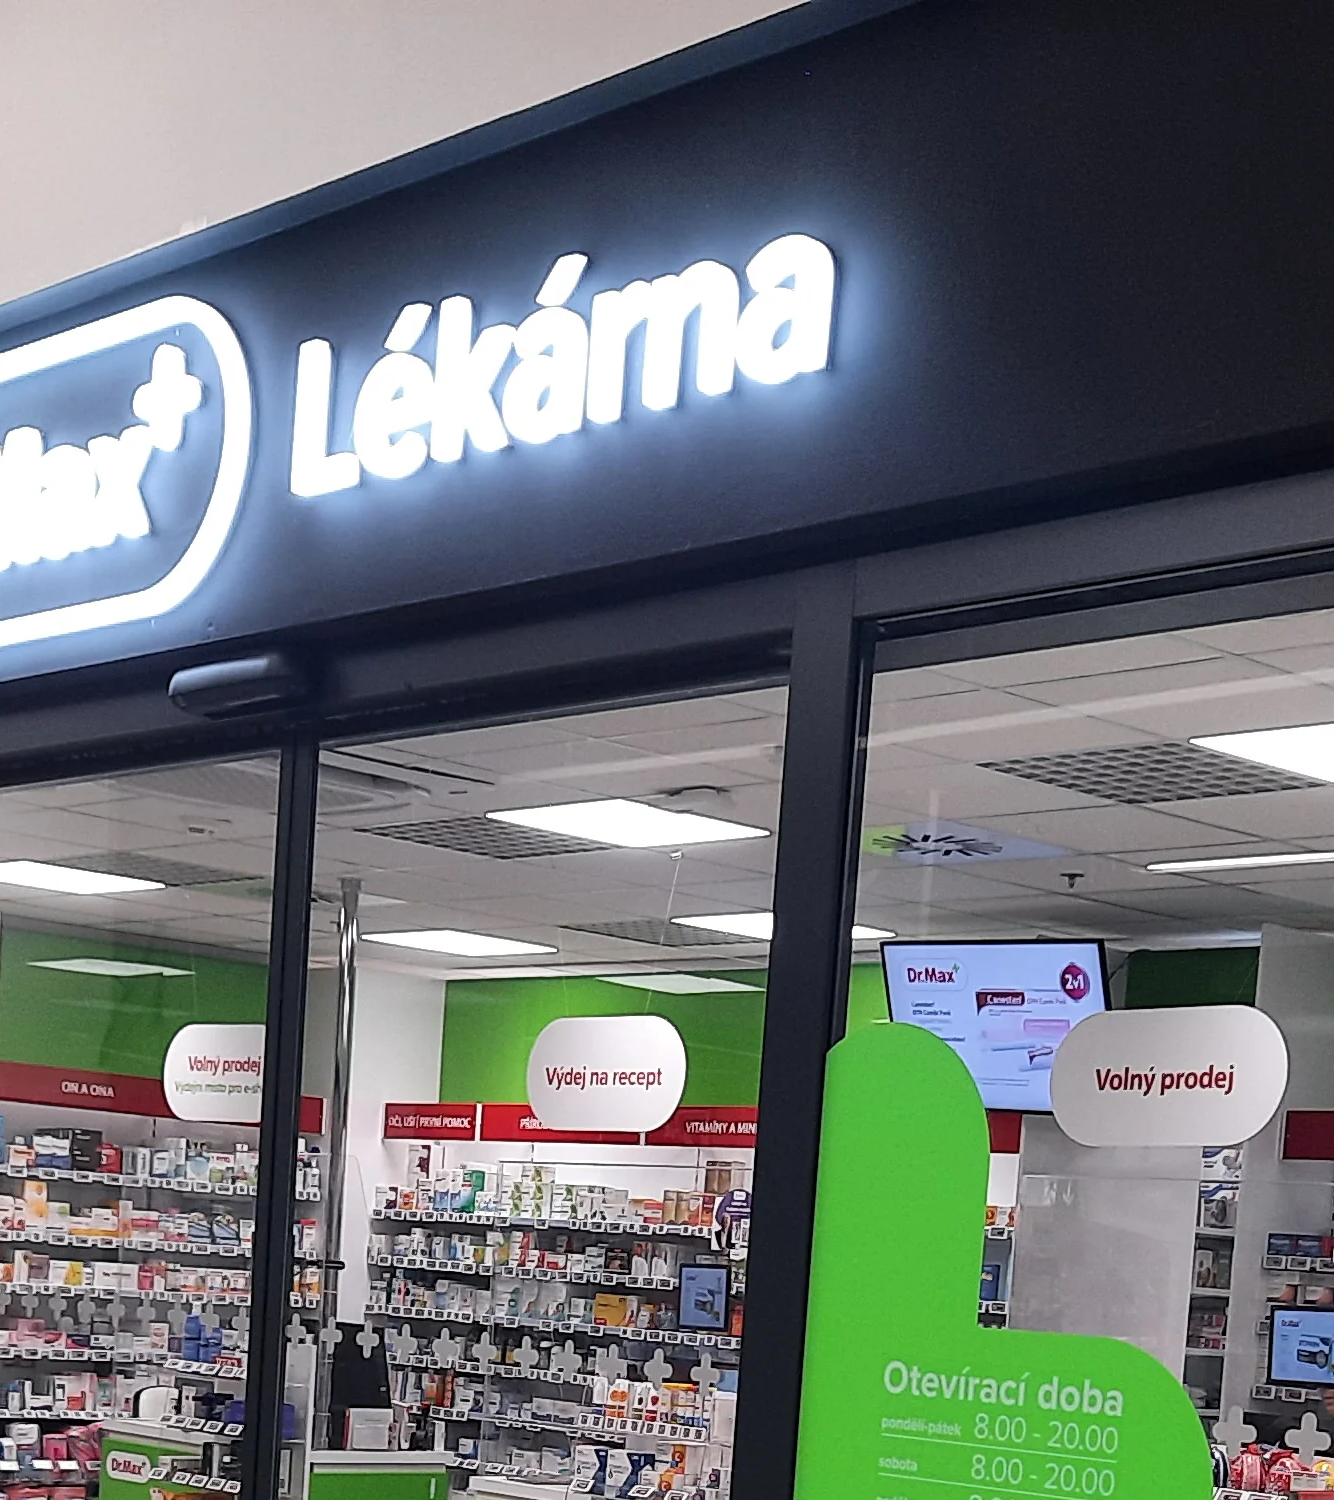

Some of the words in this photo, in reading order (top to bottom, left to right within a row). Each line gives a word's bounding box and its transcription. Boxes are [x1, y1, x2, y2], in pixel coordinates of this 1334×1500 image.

[289, 233, 838, 498] Lékárna
[907, 967, 955, 984] Dr.Max
[188, 1055, 220, 1077] Volný
[222, 1055, 262, 1077] prodej
[545, 1066, 587, 1091] Výdej
[590, 1071, 608, 1086] na
[612, 1067, 662, 1090] recept
[61, 1080, 79, 1094] ON
[80, 1083, 88, 1095] A
[90, 1083, 115, 1098] ONA
[1095, 1065, 1157, 1097] Volný
[1159, 1065, 1235, 1096] prodej
[729, 1123, 737, 1134] A
[883, 1360, 1031, 1406] Otevírací
[1037, 1376, 1125, 1417] doba
[881, 1414, 962, 1437] pondělí-pátek
[974, 1412, 1027, 1443] 8.00
[1047, 1421, 1119, 1454] 20.00
[110, 1458, 146, 1477] Dr.Max
[878, 1455, 918, 1472] sobota
[971, 1454, 1023, 1485] 8.00
[1044, 1462, 1115, 1496] 20.00
